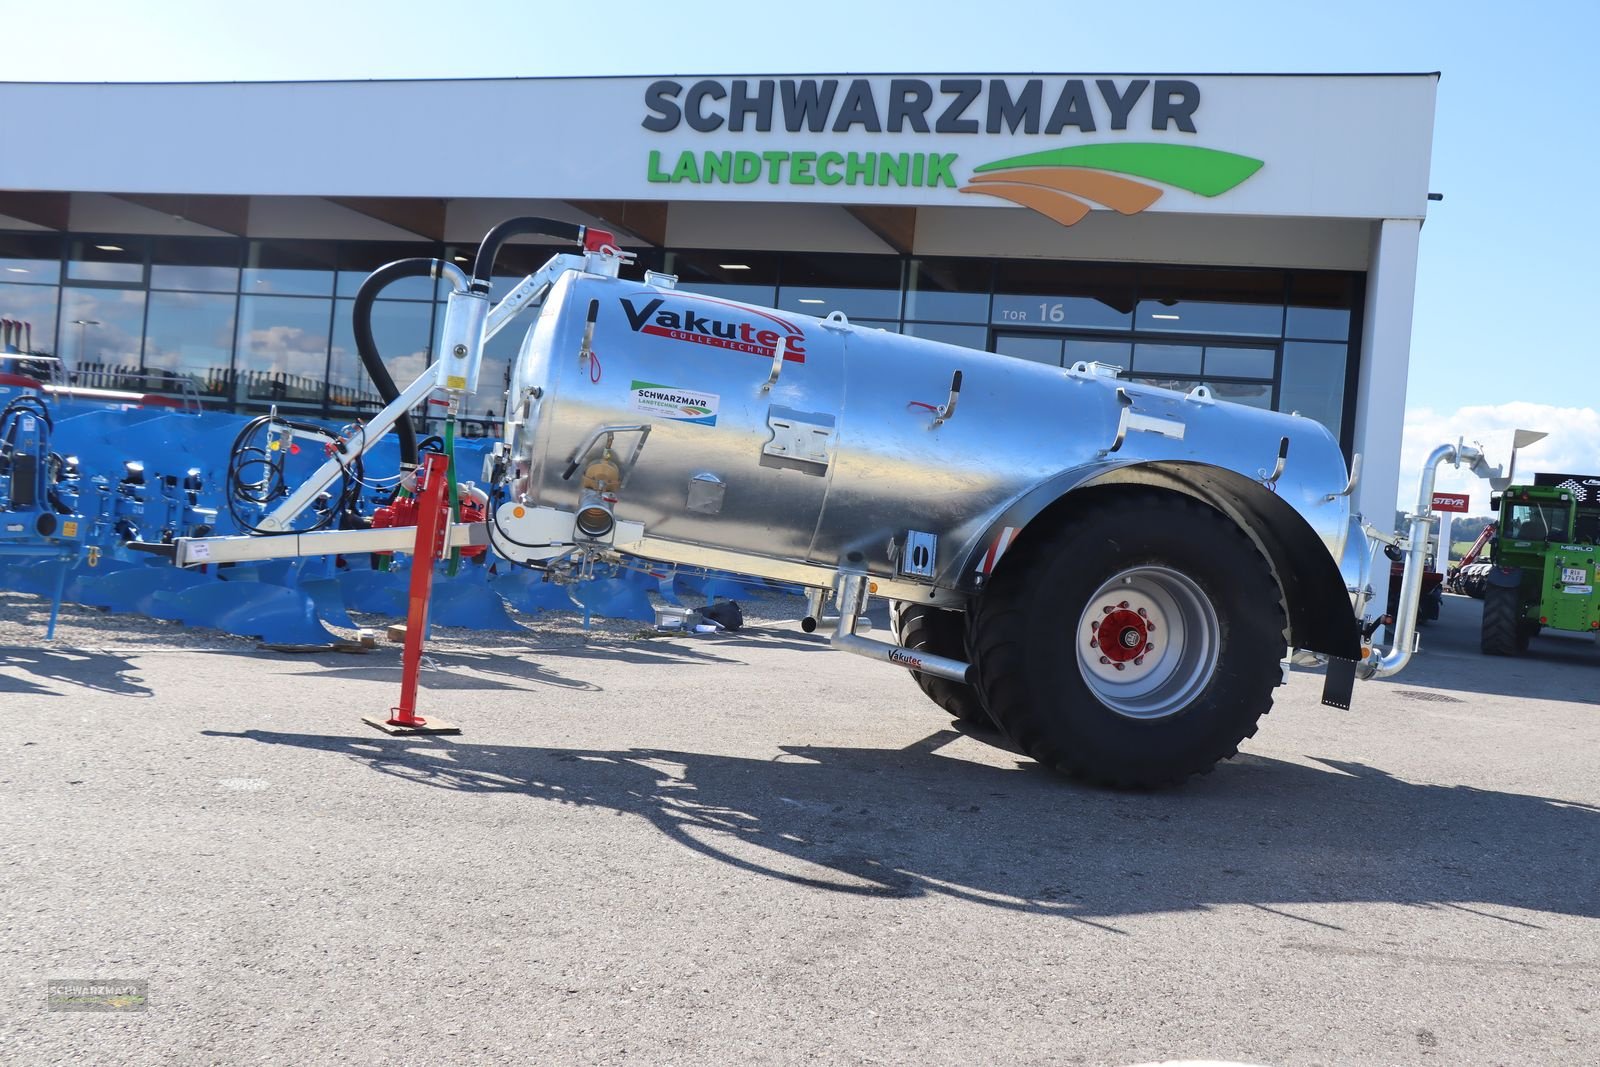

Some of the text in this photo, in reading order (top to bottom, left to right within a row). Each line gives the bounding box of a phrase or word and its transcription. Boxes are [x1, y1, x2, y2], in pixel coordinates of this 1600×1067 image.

[641, 77, 1201, 136] SCHWARZMAYR
[647, 150, 959, 188] LANDTECHNIK
[1003, 303, 1065, 322] TOR 16
[619, 298, 807, 353] Vakutec
[638, 389, 707, 407] SCHWARZMAYR
[1432, 497, 1465, 506] STEYR
[888, 649, 922, 666] Vakutec
